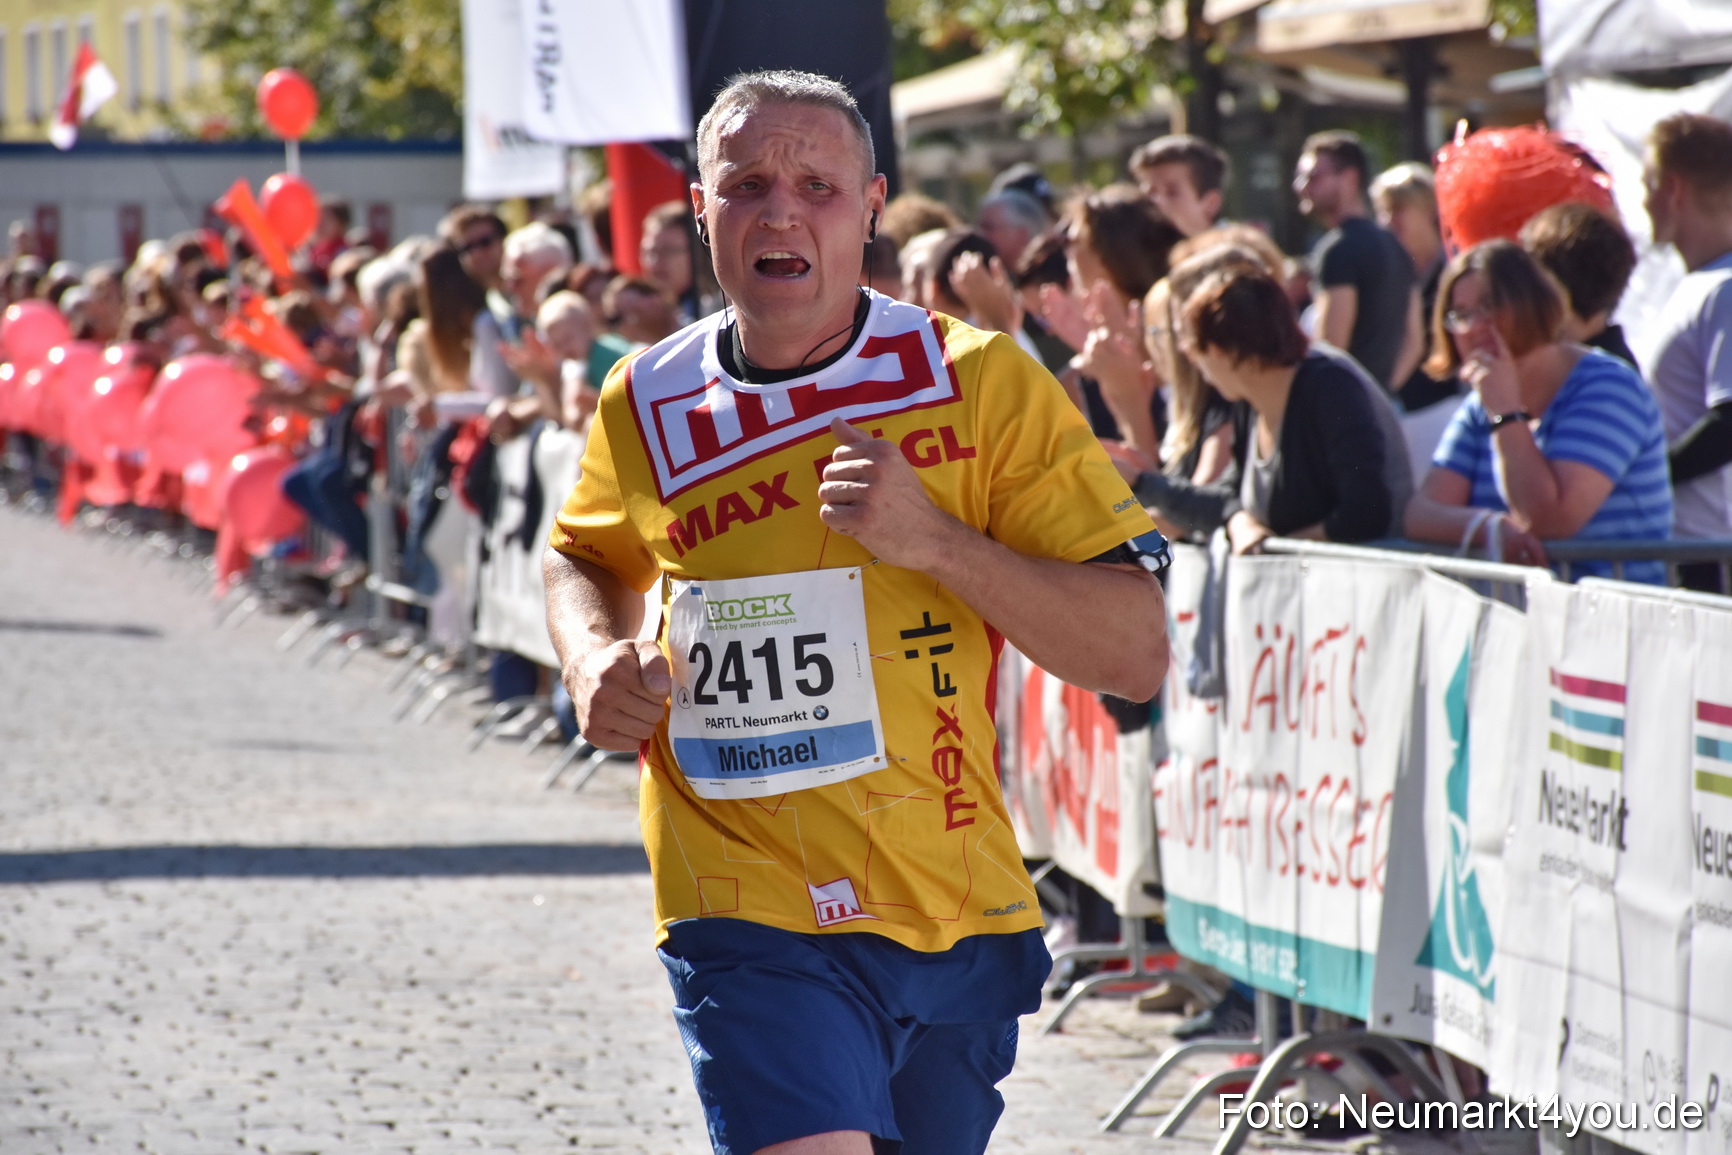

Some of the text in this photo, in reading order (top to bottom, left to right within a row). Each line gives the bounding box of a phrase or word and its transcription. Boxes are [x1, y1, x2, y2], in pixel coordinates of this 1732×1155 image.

[665, 471, 801, 557] MAX
[705, 593, 795, 622] BOCK
[729, 623, 738, 631] by
[739, 620, 761, 629] smart
[762, 617, 797, 627] concepts
[688, 632, 834, 706] 2415
[705, 716, 741, 729] PARTL
[743, 711, 808, 728] Neumarkt
[718, 735, 819, 772] Michael
